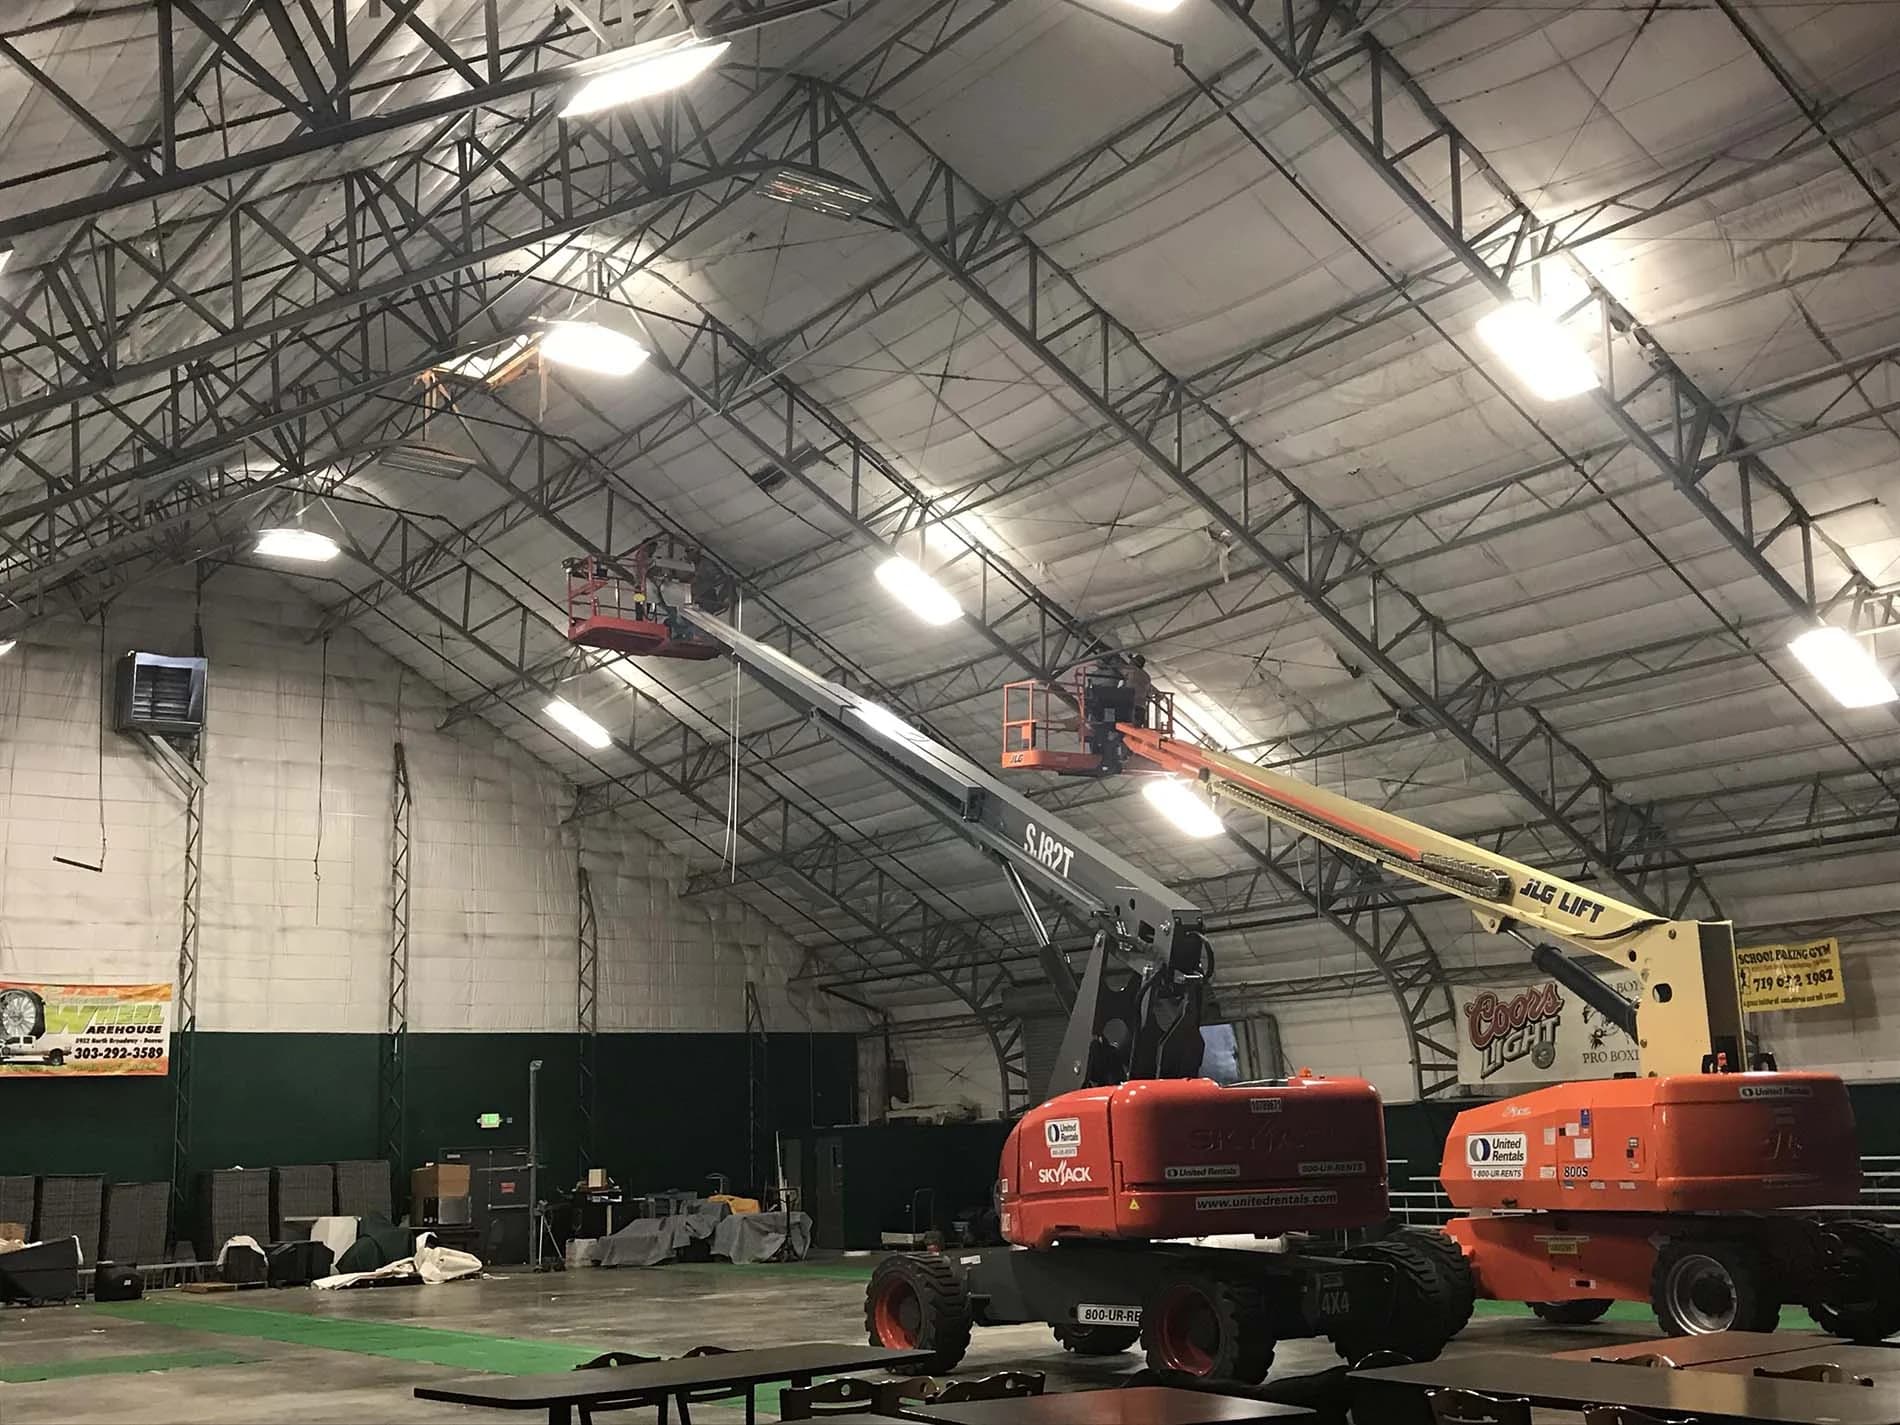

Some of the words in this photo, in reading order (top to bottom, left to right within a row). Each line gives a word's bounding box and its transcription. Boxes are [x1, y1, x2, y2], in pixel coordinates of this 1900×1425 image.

[1024, 823, 1074, 878] SJ82T
[1520, 878, 1557, 905] JLG
[1558, 891, 1605, 923] LIFT
[1738, 950, 1774, 964] SCHOOL
[1809, 943, 1831, 959] GYM
[1753, 976, 1773, 992] 719
[1806, 968, 1834, 986] 1982
[1464, 983, 1565, 1049] Coors
[86, 1025, 162, 1034] AREHOUSE
[74, 1046, 163, 1059] 303-292-3589
[1481, 1015, 1560, 1080] LIGHT
[1582, 1051, 1608, 1064] PRO
[1061, 1123, 1076, 1132] United
[1492, 1137, 1522, 1150] United
[1492, 1149, 1524, 1163] Rentals
[1039, 1159, 1092, 1186] SKYJACK
[1179, 1168, 1206, 1177] United
[1208, 1166, 1237, 1176] Rentals
[1564, 1165, 1589, 1178] 800S
[1197, 1192, 1337, 1209] www.unitedrentals.com
[1321, 1291, 1350, 1315] 4X4
